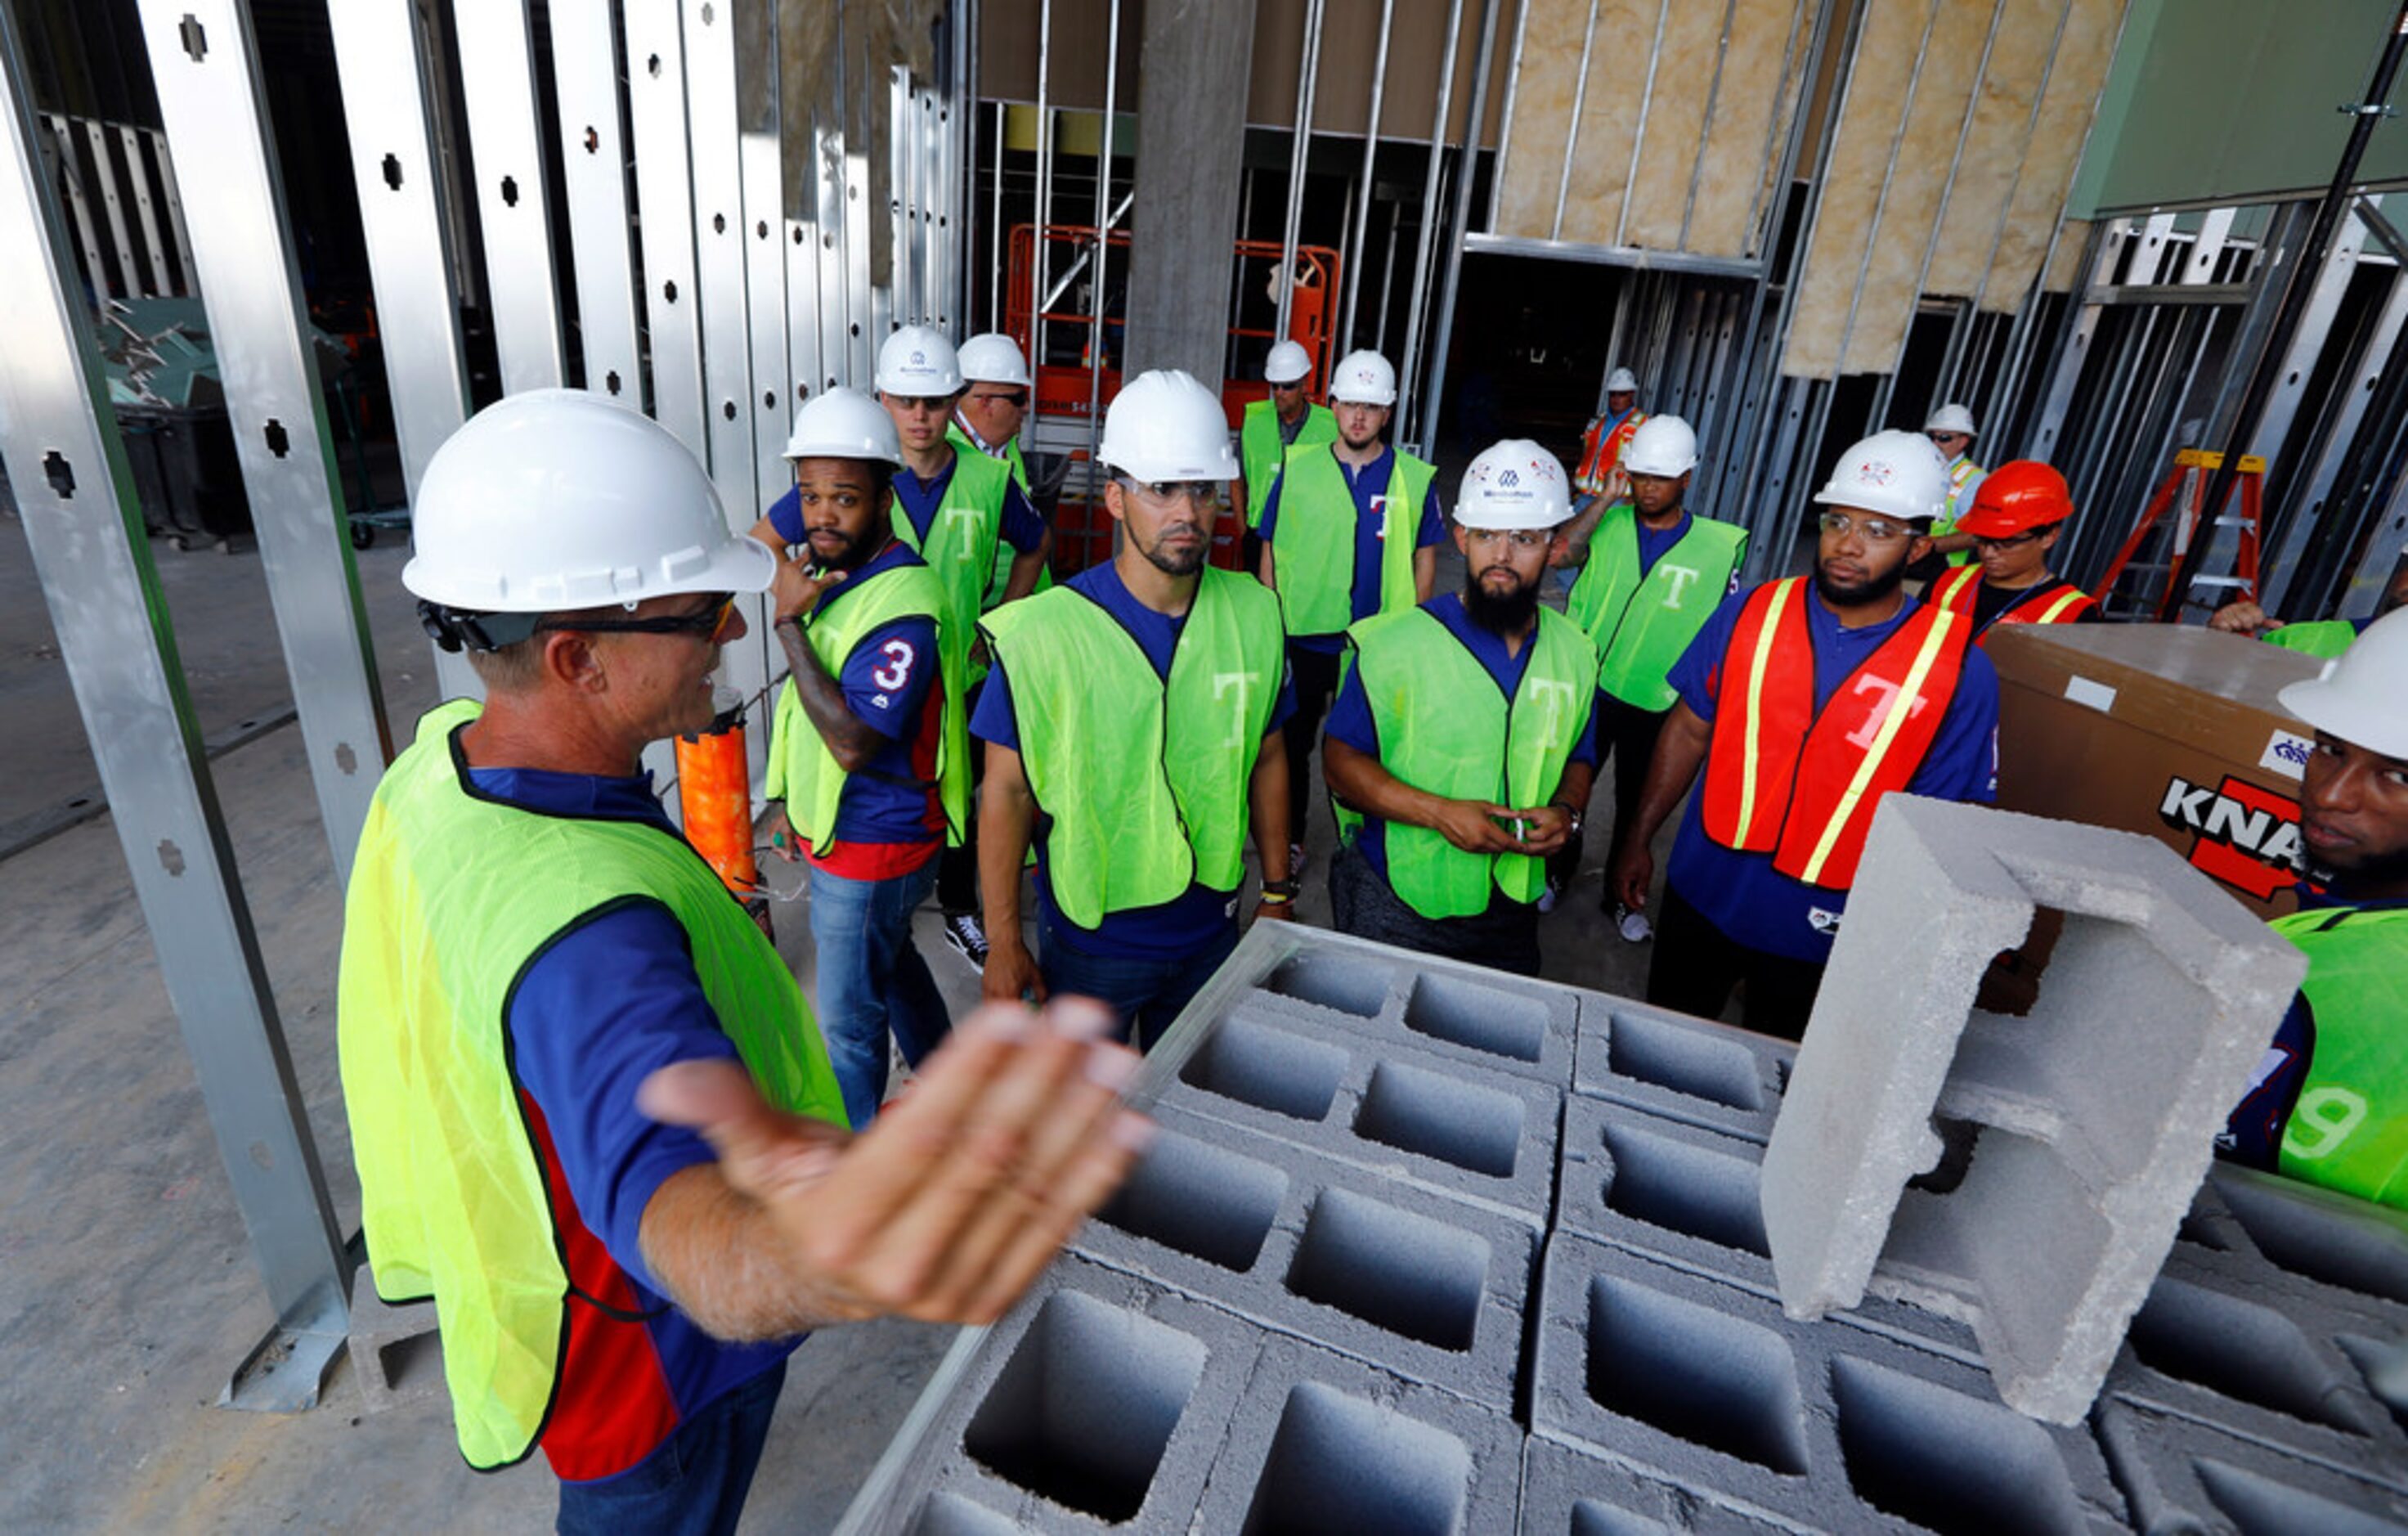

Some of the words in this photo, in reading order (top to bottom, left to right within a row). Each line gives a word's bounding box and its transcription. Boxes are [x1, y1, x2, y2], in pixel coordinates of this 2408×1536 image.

[945, 509, 985, 559] T
[1660, 564, 1700, 609] T
[873, 638, 915, 692] 3
[1214, 672, 1260, 747] T
[1531, 677, 1574, 748] T
[1845, 673, 1928, 750] T
[2160, 777, 2305, 871] KNA
